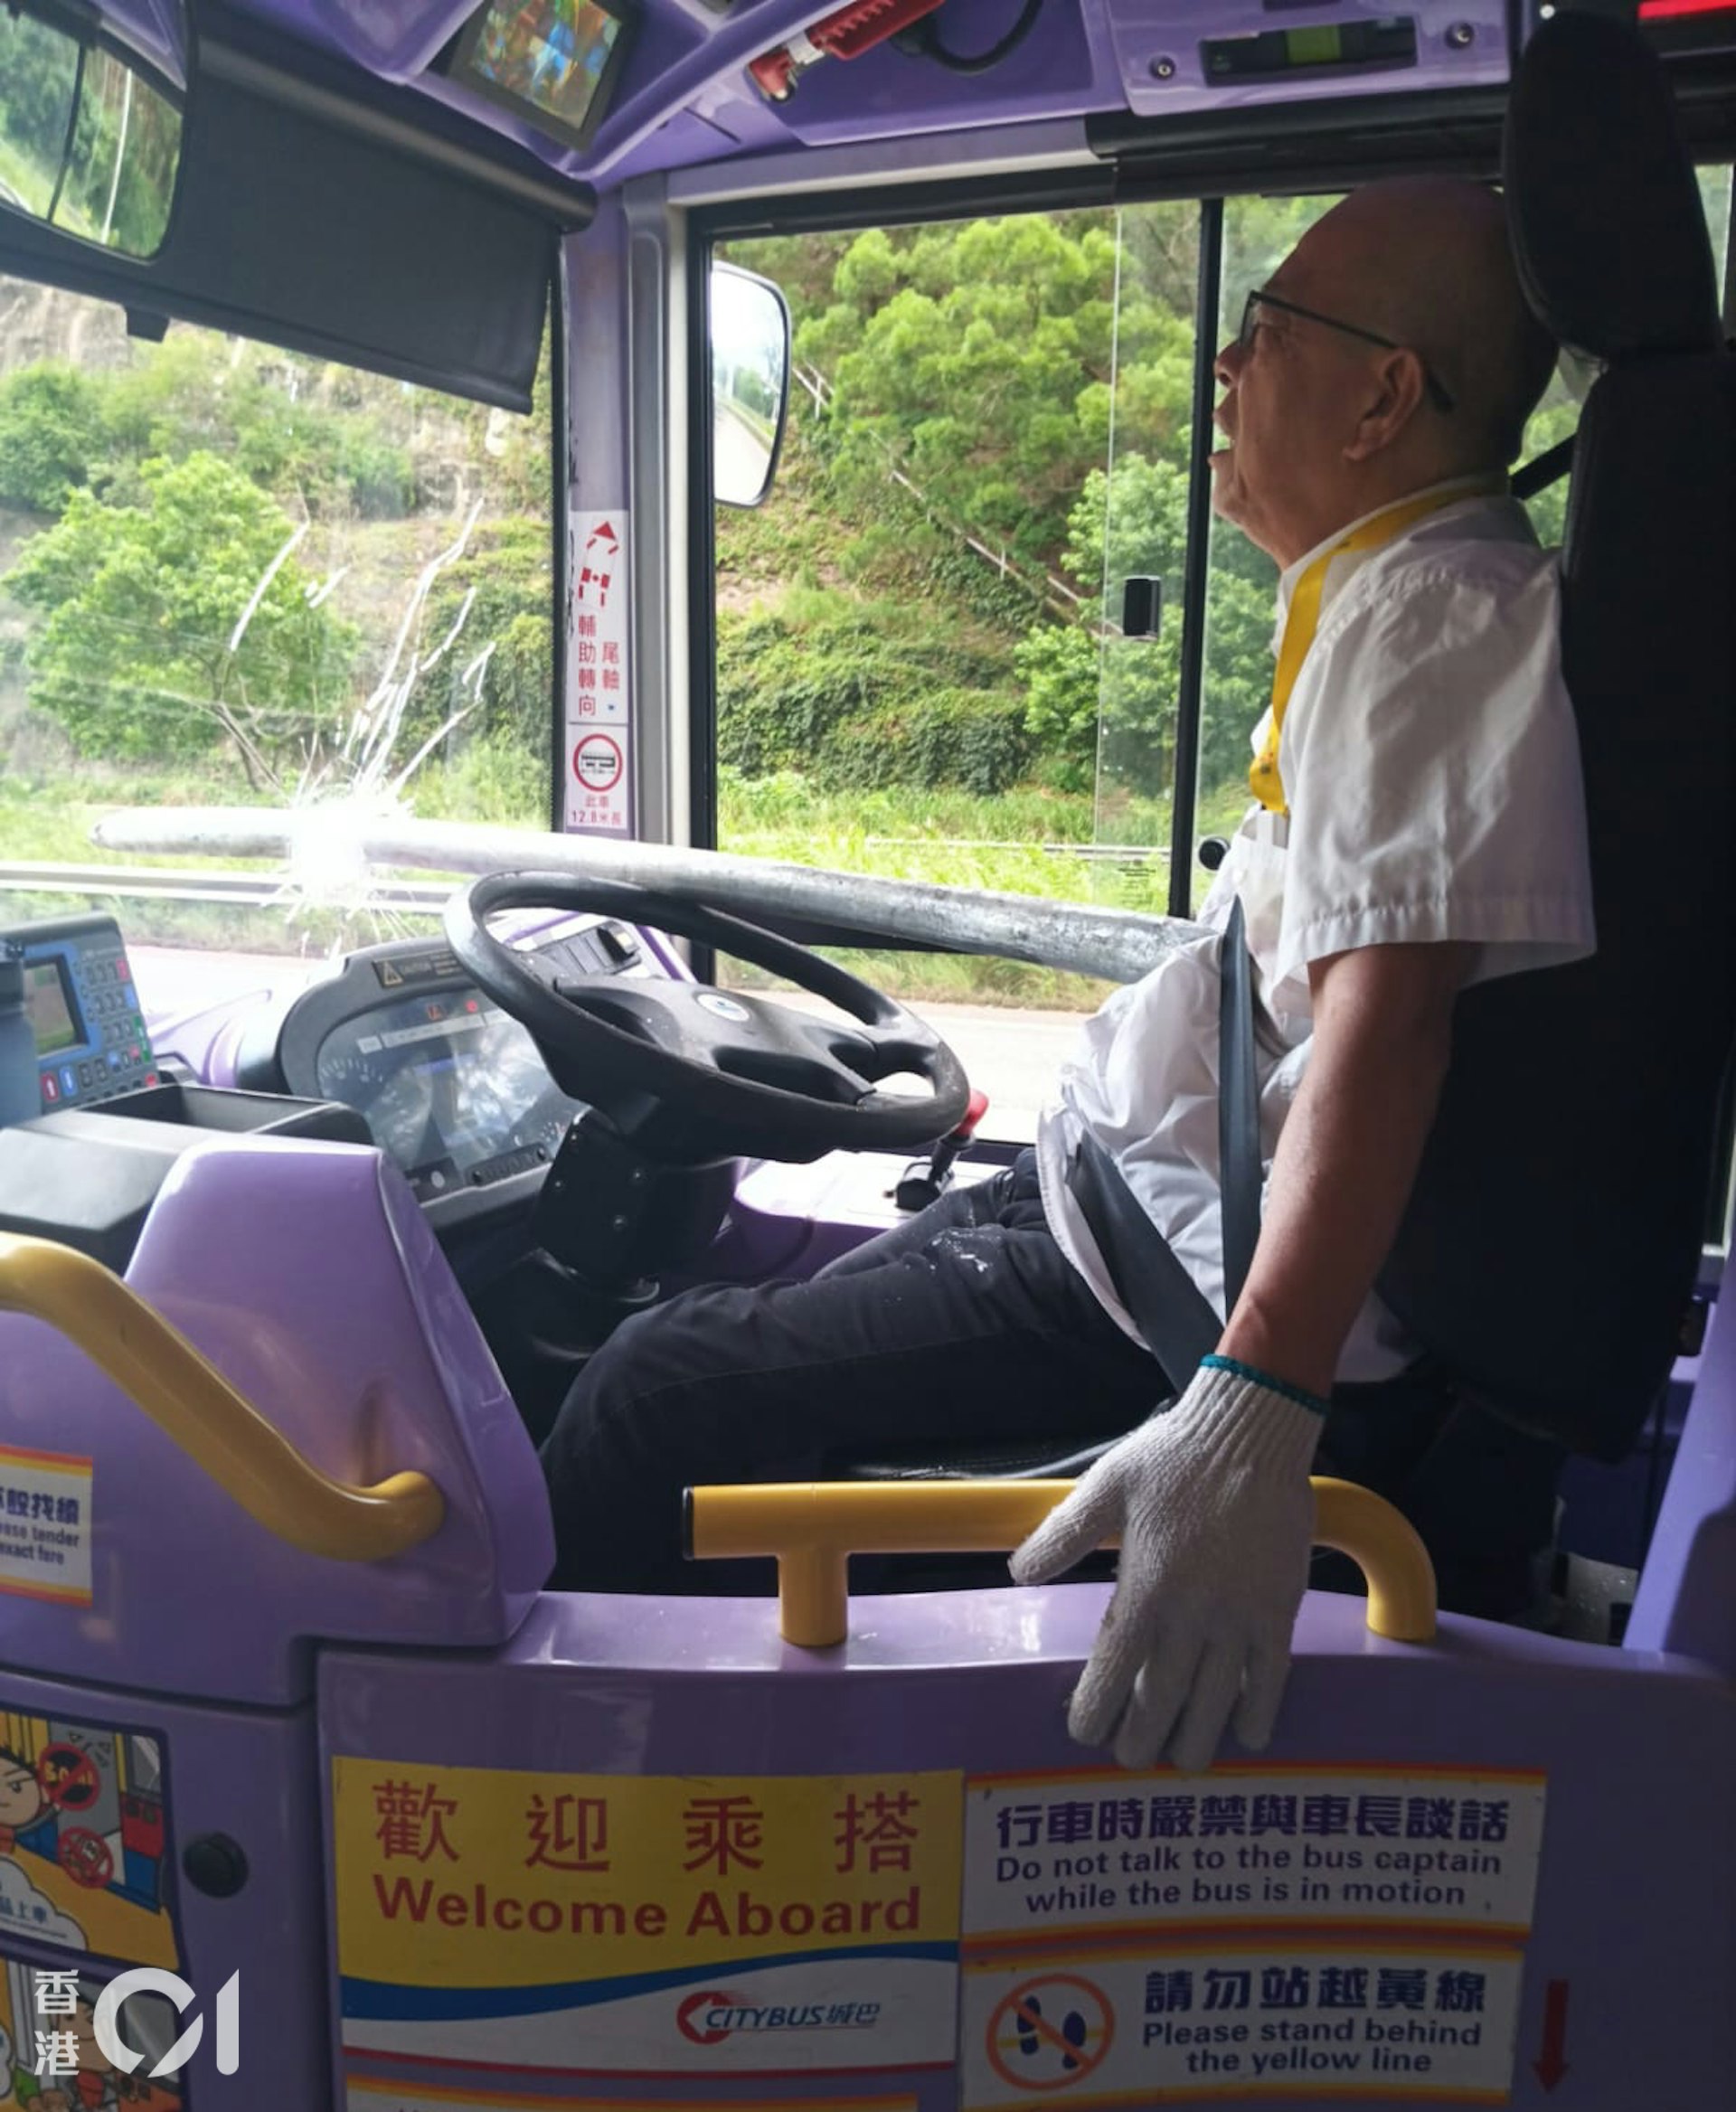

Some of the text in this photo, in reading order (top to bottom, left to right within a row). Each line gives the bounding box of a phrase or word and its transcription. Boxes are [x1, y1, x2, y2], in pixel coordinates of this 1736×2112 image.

[578, 615, 597, 717] 輔助轉向
[32, 1526, 80, 1549] tender
[373, 1779, 920, 1876] 歡迎乘搭
[996, 1794, 1509, 1849] 行車時嚴禁與車長談話
[996, 1844, 1502, 1881] Do not talk to the bus captain
[373, 1873, 920, 1938] Welcome Aboard
[1026, 1877, 1465, 1912] while the bus is in motion
[1144, 1966, 1486, 2013] 請勿站越黃線
[706, 2002, 881, 2028] CITYBUS 城巴
[1143, 2017, 1482, 2047] Please stand behind
[1186, 2046, 1431, 2075] the yellow line
